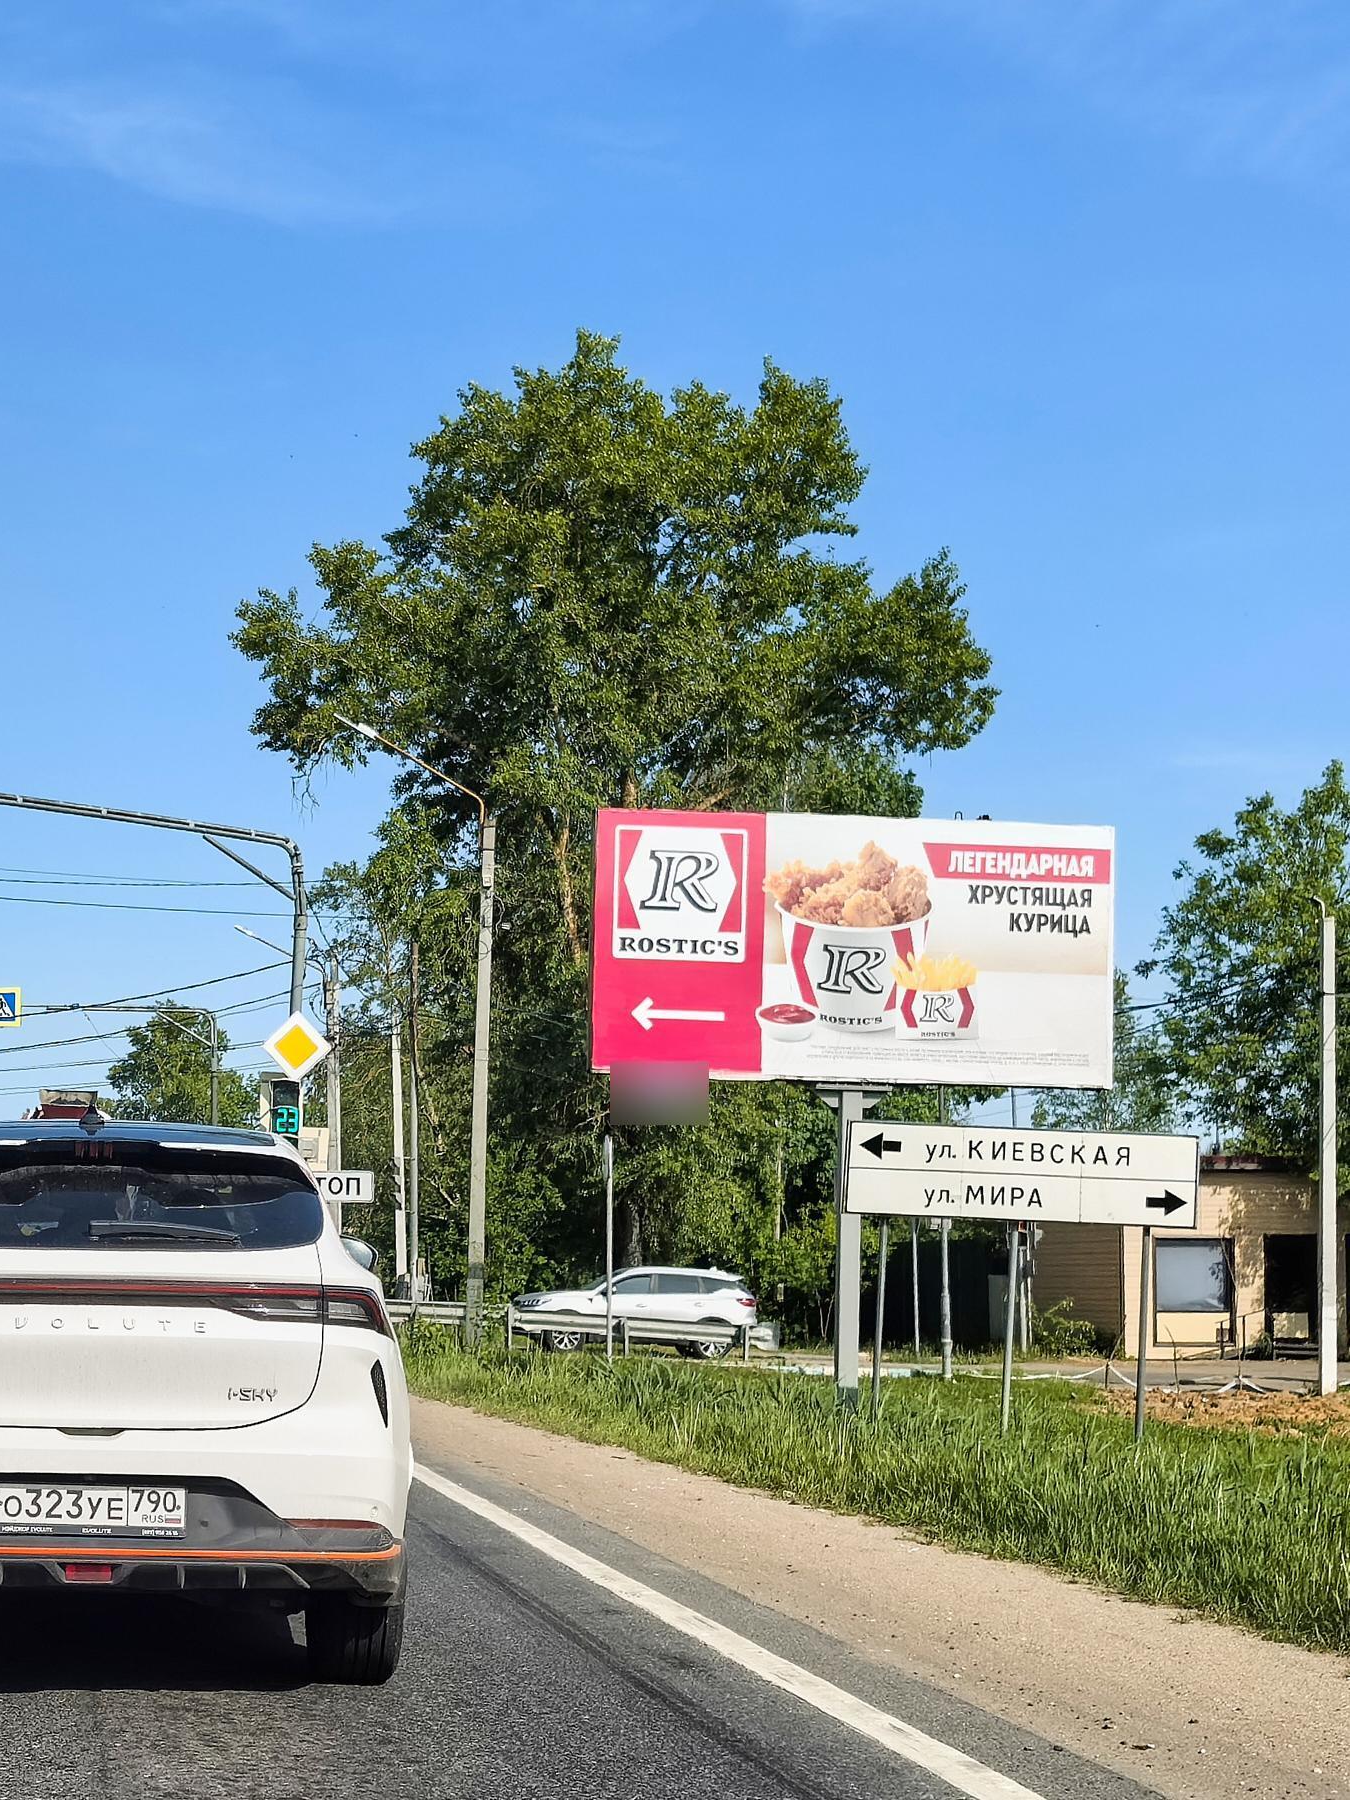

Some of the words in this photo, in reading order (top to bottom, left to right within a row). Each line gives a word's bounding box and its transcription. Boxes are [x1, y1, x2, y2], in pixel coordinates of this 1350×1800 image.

[948, 850, 1095, 879] ЛЕГЕНДАРНАЯ
[967, 884, 1092, 910] ХРУСТЯЩАЯ
[1009, 912, 1091, 938] КУРИЦА
[618, 936, 739, 956] ROSTIC'S
[819, 1013, 883, 1026] ROSTIC'S
[276, 1108, 299, 1133] 23
[925, 1143, 957, 1164] ул.
[968, 1139, 1131, 1167] КИЕВСКАЯ
[315, 1176, 361, 1196] ТОП
[924, 1187, 956, 1208] ул.
[965, 1185, 1043, 1208] МИРА
[131, 1489, 177, 1513] 790
[141, 1514, 164, 1524] RUS
